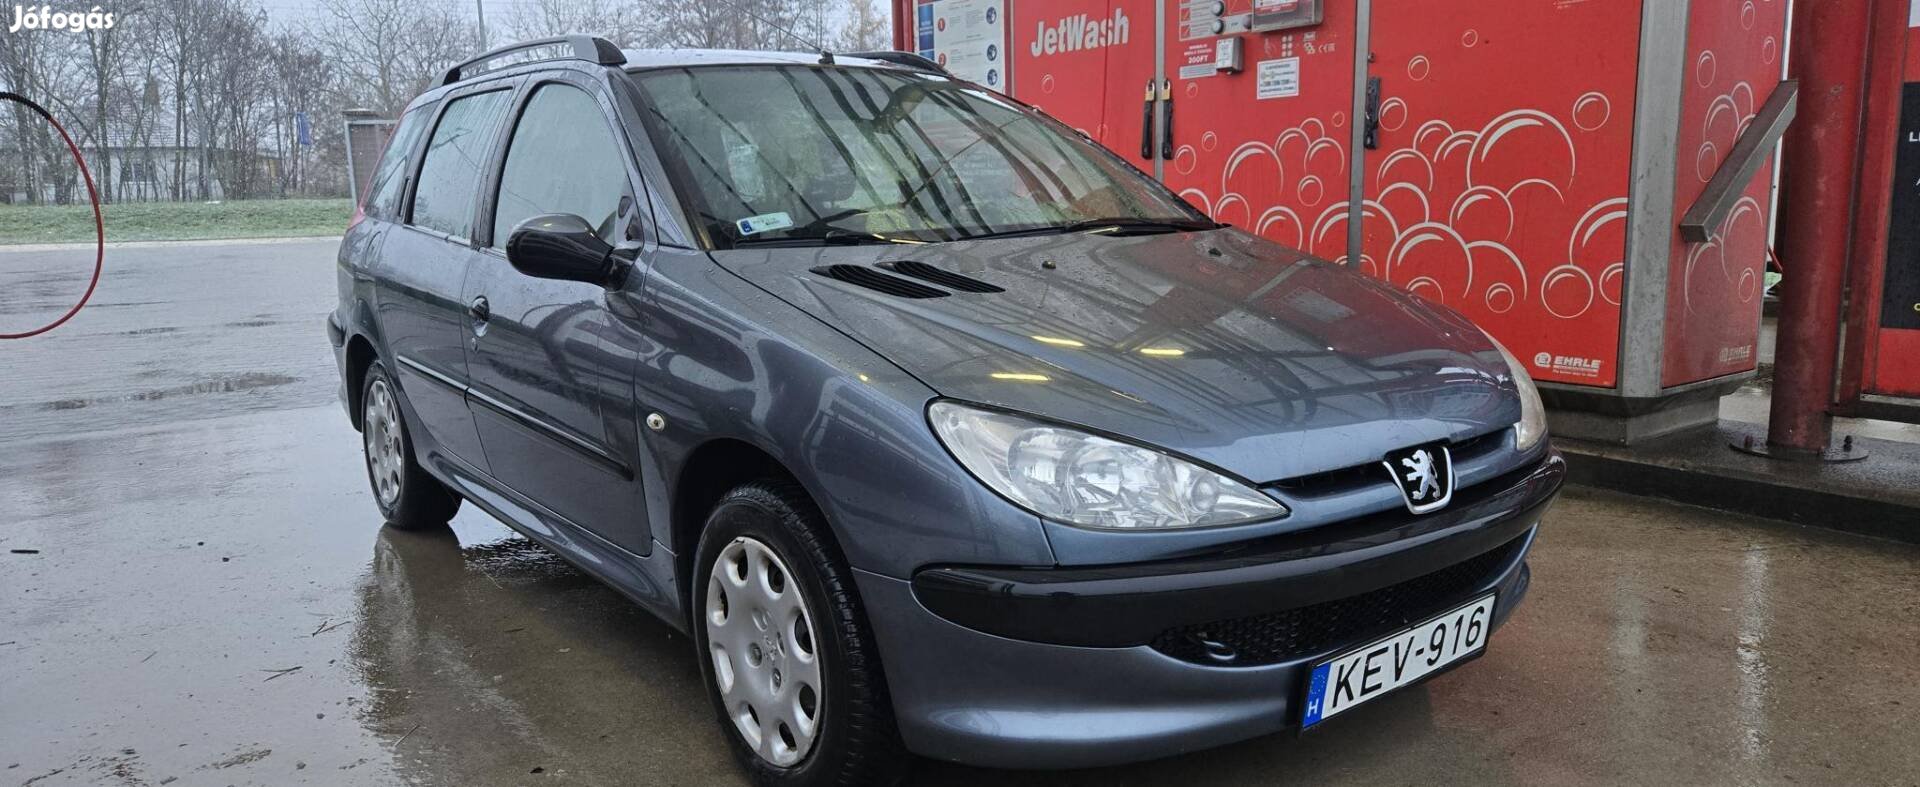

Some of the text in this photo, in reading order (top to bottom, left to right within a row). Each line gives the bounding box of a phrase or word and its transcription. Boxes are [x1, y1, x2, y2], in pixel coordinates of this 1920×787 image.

[1031, 8, 1129, 57] JetWash
[1554, 356, 1601, 369] EHRLE
[1332, 605, 1485, 708] KEV-916
[1307, 699, 1318, 718] H
